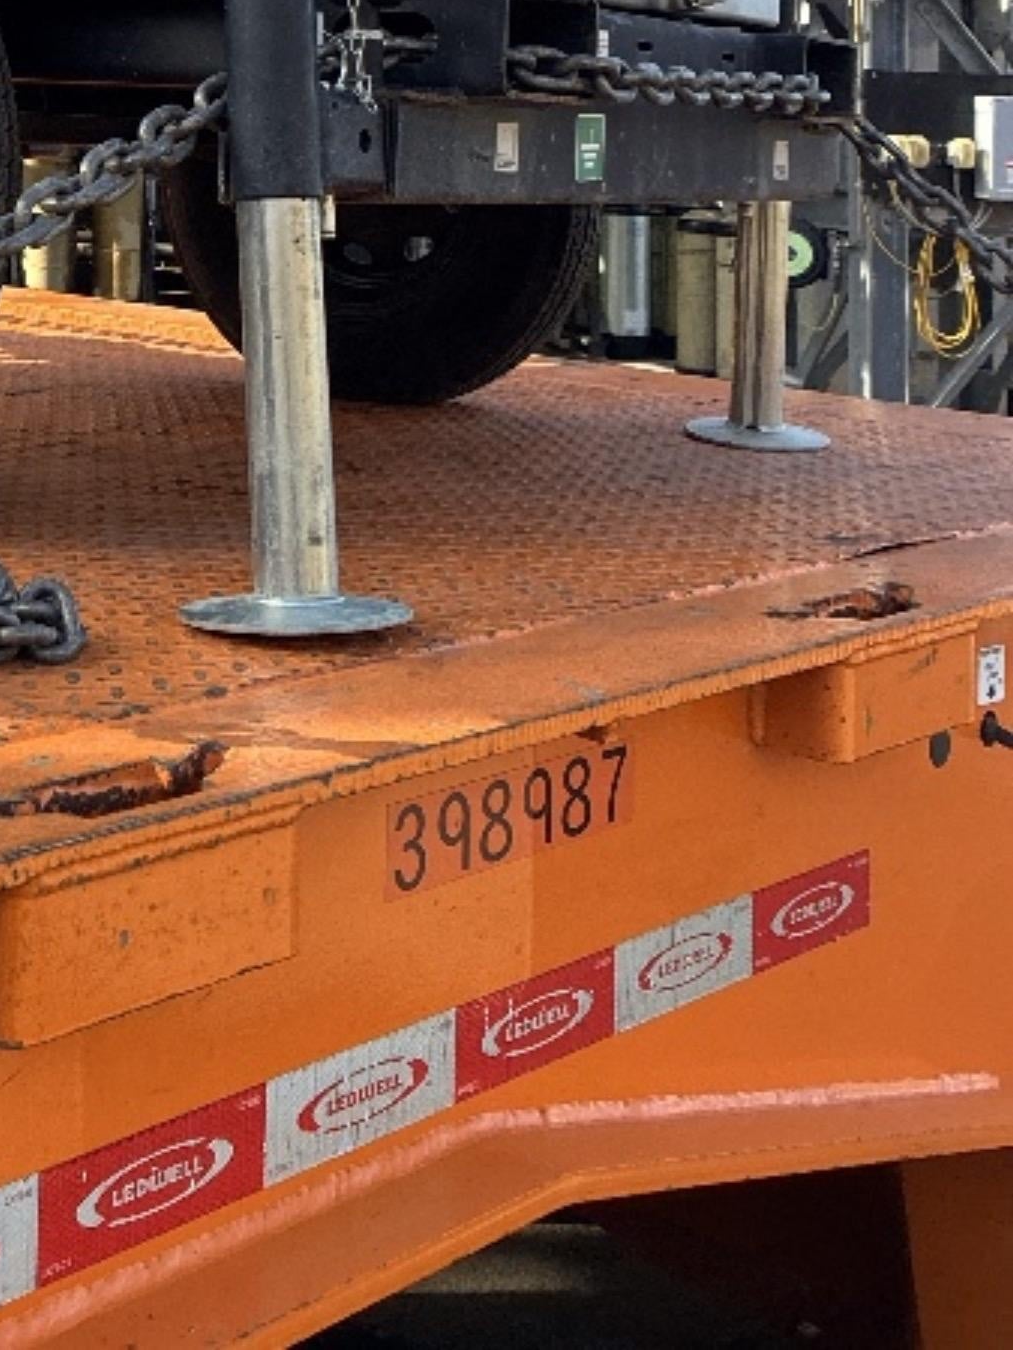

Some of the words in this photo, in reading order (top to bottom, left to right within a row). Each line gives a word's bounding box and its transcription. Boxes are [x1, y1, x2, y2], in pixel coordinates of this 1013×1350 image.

[393, 743, 628, 892] 398987
[326, 1072, 404, 1118] LEDWELL
[111, 1155, 206, 1208] LEDWELL
